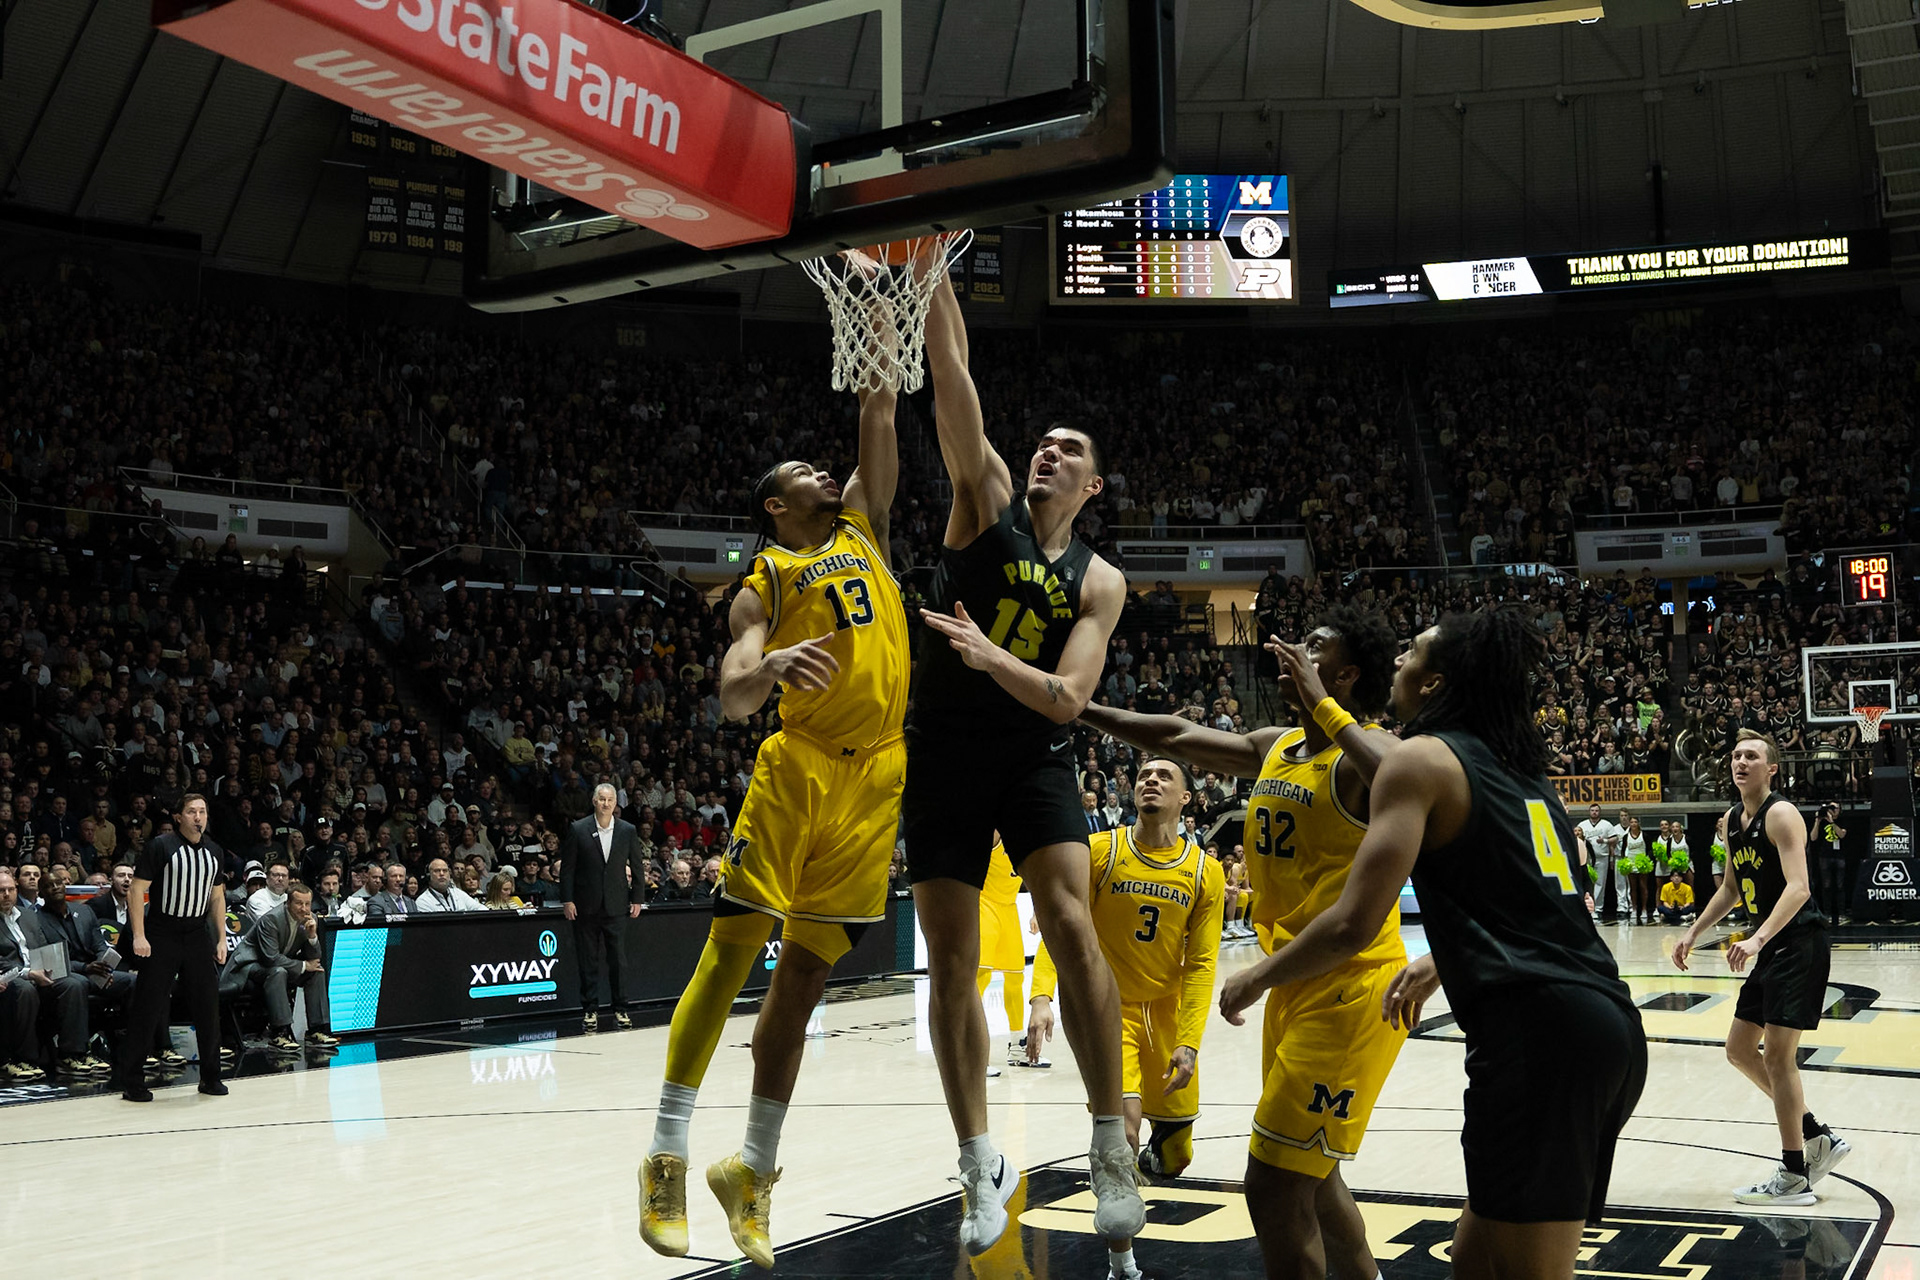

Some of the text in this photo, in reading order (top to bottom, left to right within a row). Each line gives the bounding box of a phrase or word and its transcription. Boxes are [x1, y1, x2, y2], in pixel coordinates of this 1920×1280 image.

[351, 131, 377, 148] 1935
[390, 137, 416, 154] 1936
[368, 176, 399, 189] PURDUE
[406, 181, 438, 194] PURDUE
[1239, 182, 1272, 205] M
[369, 204, 397, 215] BIG TEN
[410, 201, 432, 212] MEN'S
[367, 213, 398, 223] CHAMPS
[407, 209, 434, 220] BIG TEN
[406, 217, 436, 229] CHAMPS
[1063, 220, 1073, 228] 32
[1076, 220, 1100, 228] Reed
[1100, 220, 1114, 228] Jr.
[368, 230, 397, 244] 1979
[406, 235, 434, 249] 1984
[1135, 232, 1142, 240] P
[1152, 232, 1159, 240] R
[1169, 232, 1176, 240] A
[1204, 232, 1210, 240] F
[1076, 244, 1103, 252] Loyer
[1076, 254, 1104, 262] Smith
[1567, 237, 1849, 275] THANK YOU FOR YOUR DONATION!
[1472, 262, 1515, 273] HAMMER
[1570, 256, 1849, 285] ALL PROCEEDS GO TOWARDS THE PURDUE INSTITUTE FOR CANCER RESEARCH
[974, 282, 1001, 293] 2023
[1077, 286, 1106, 294] Jones
[1135, 286, 1145, 294] 12
[616, 327, 646, 347] 103
[1851, 558, 1888, 574] 18:00
[1003, 560, 1073, 619] PURDUE
[1861, 574, 1886, 599] 19
[824, 578, 874, 631] 13
[988, 597, 1048, 661] 15
[1603, 777, 1630, 789] LIVES
[1604, 789, 1631, 802] HERE
[1255, 806, 1296, 859] 32
[1524, 799, 1578, 895] 4
[1111, 880, 1191, 909] MICHIGAN
[1741, 878, 1759, 914] 2
[1867, 888, 1918, 901] PIONEER
[1134, 904, 1160, 942] 3
[470, 959, 557, 985] XYWAY
[518, 993, 558, 1004] FUNGICIDES
[1307, 1082, 1356, 1120] M
